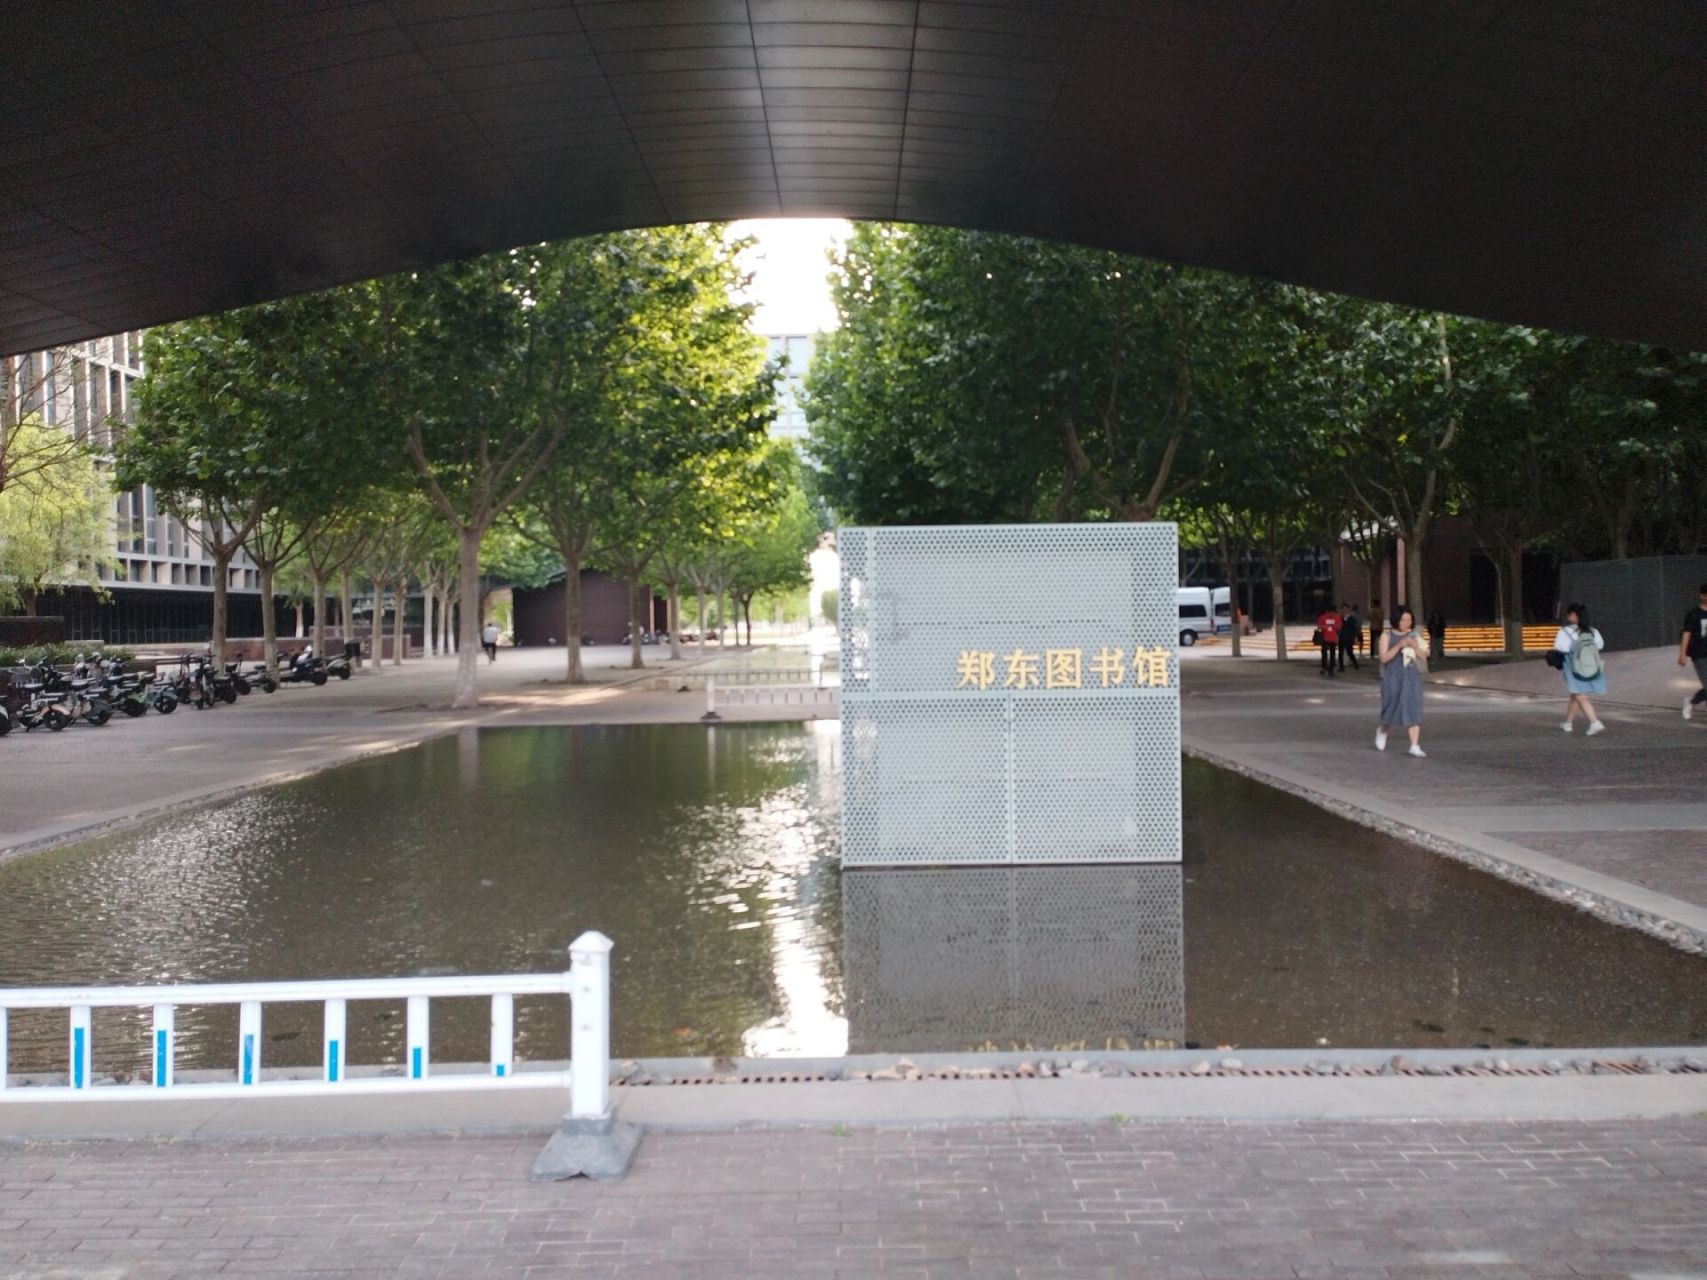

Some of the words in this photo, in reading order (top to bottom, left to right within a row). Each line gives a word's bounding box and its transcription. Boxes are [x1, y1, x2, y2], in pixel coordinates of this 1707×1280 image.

[957, 646, 1171, 690] 郑东图书馆
